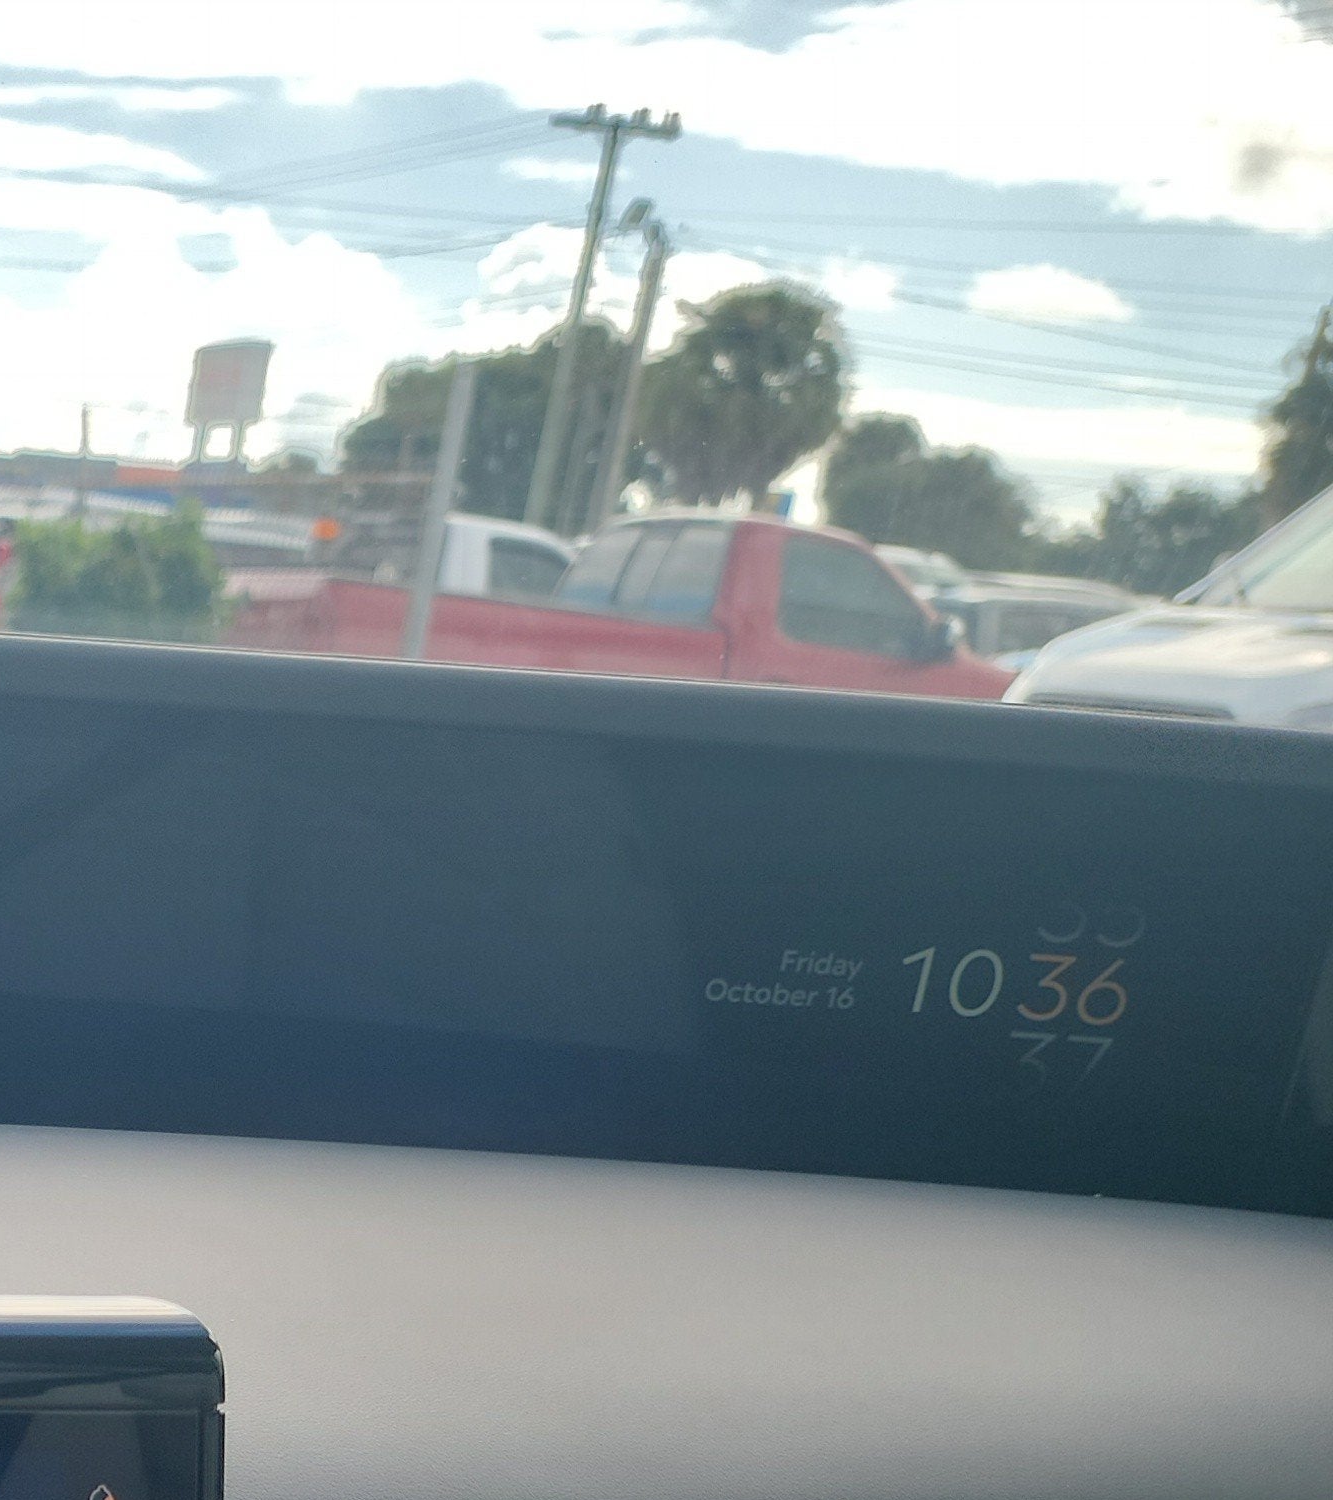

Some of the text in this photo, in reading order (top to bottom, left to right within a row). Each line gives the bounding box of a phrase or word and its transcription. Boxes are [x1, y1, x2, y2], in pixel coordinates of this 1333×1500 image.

[780, 950, 864, 982] Friday
[705, 978, 856, 1010] October 16
[901, 946, 1128, 1026] 10 36
